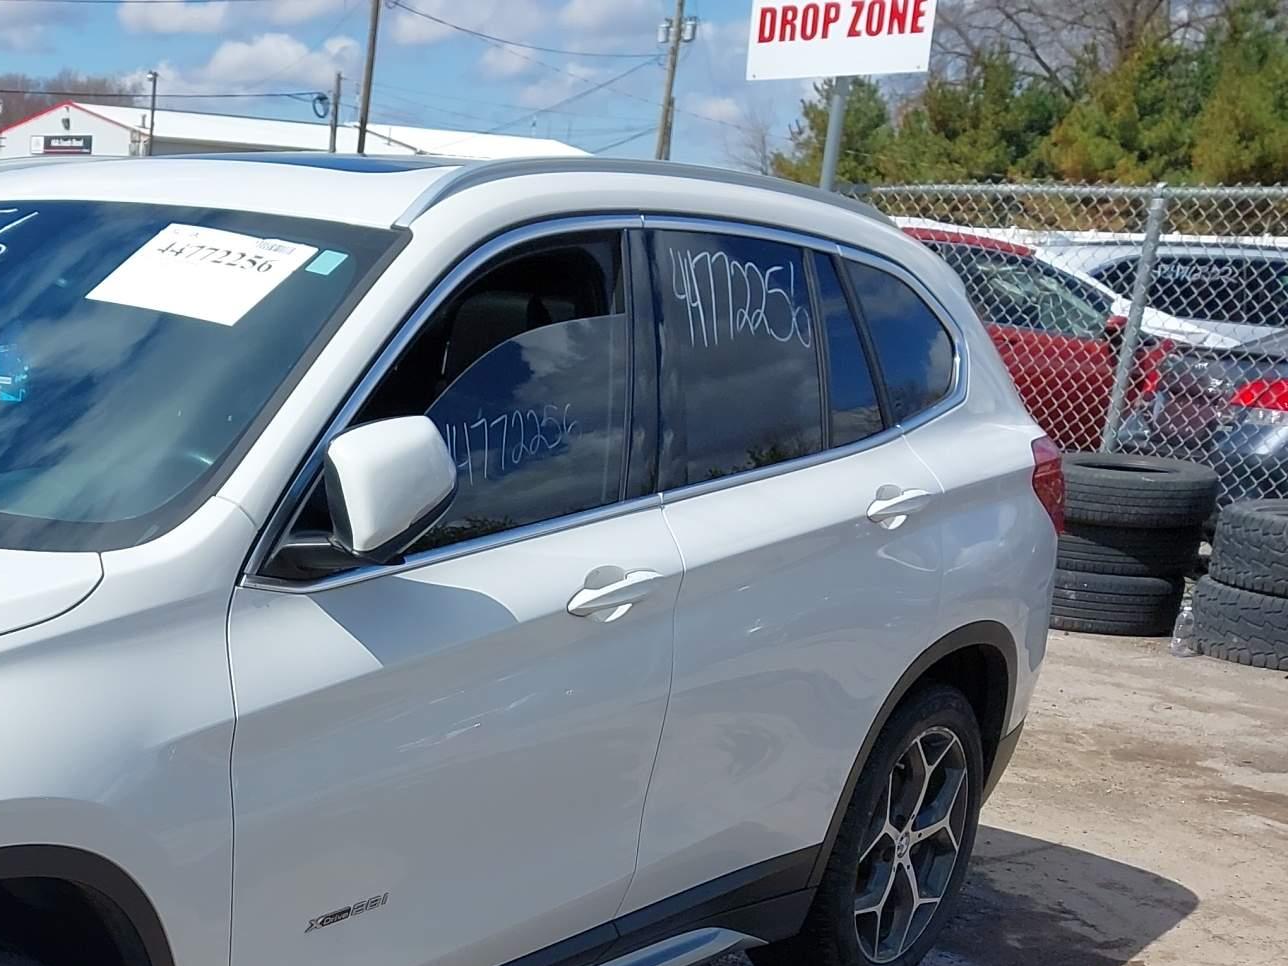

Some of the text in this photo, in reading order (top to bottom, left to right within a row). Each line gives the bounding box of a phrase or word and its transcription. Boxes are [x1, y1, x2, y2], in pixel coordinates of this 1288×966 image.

[758, 0, 928, 43] DROP ZONE
[156, 240, 279, 273] 44772256
[669, 247, 811, 348] 44772256
